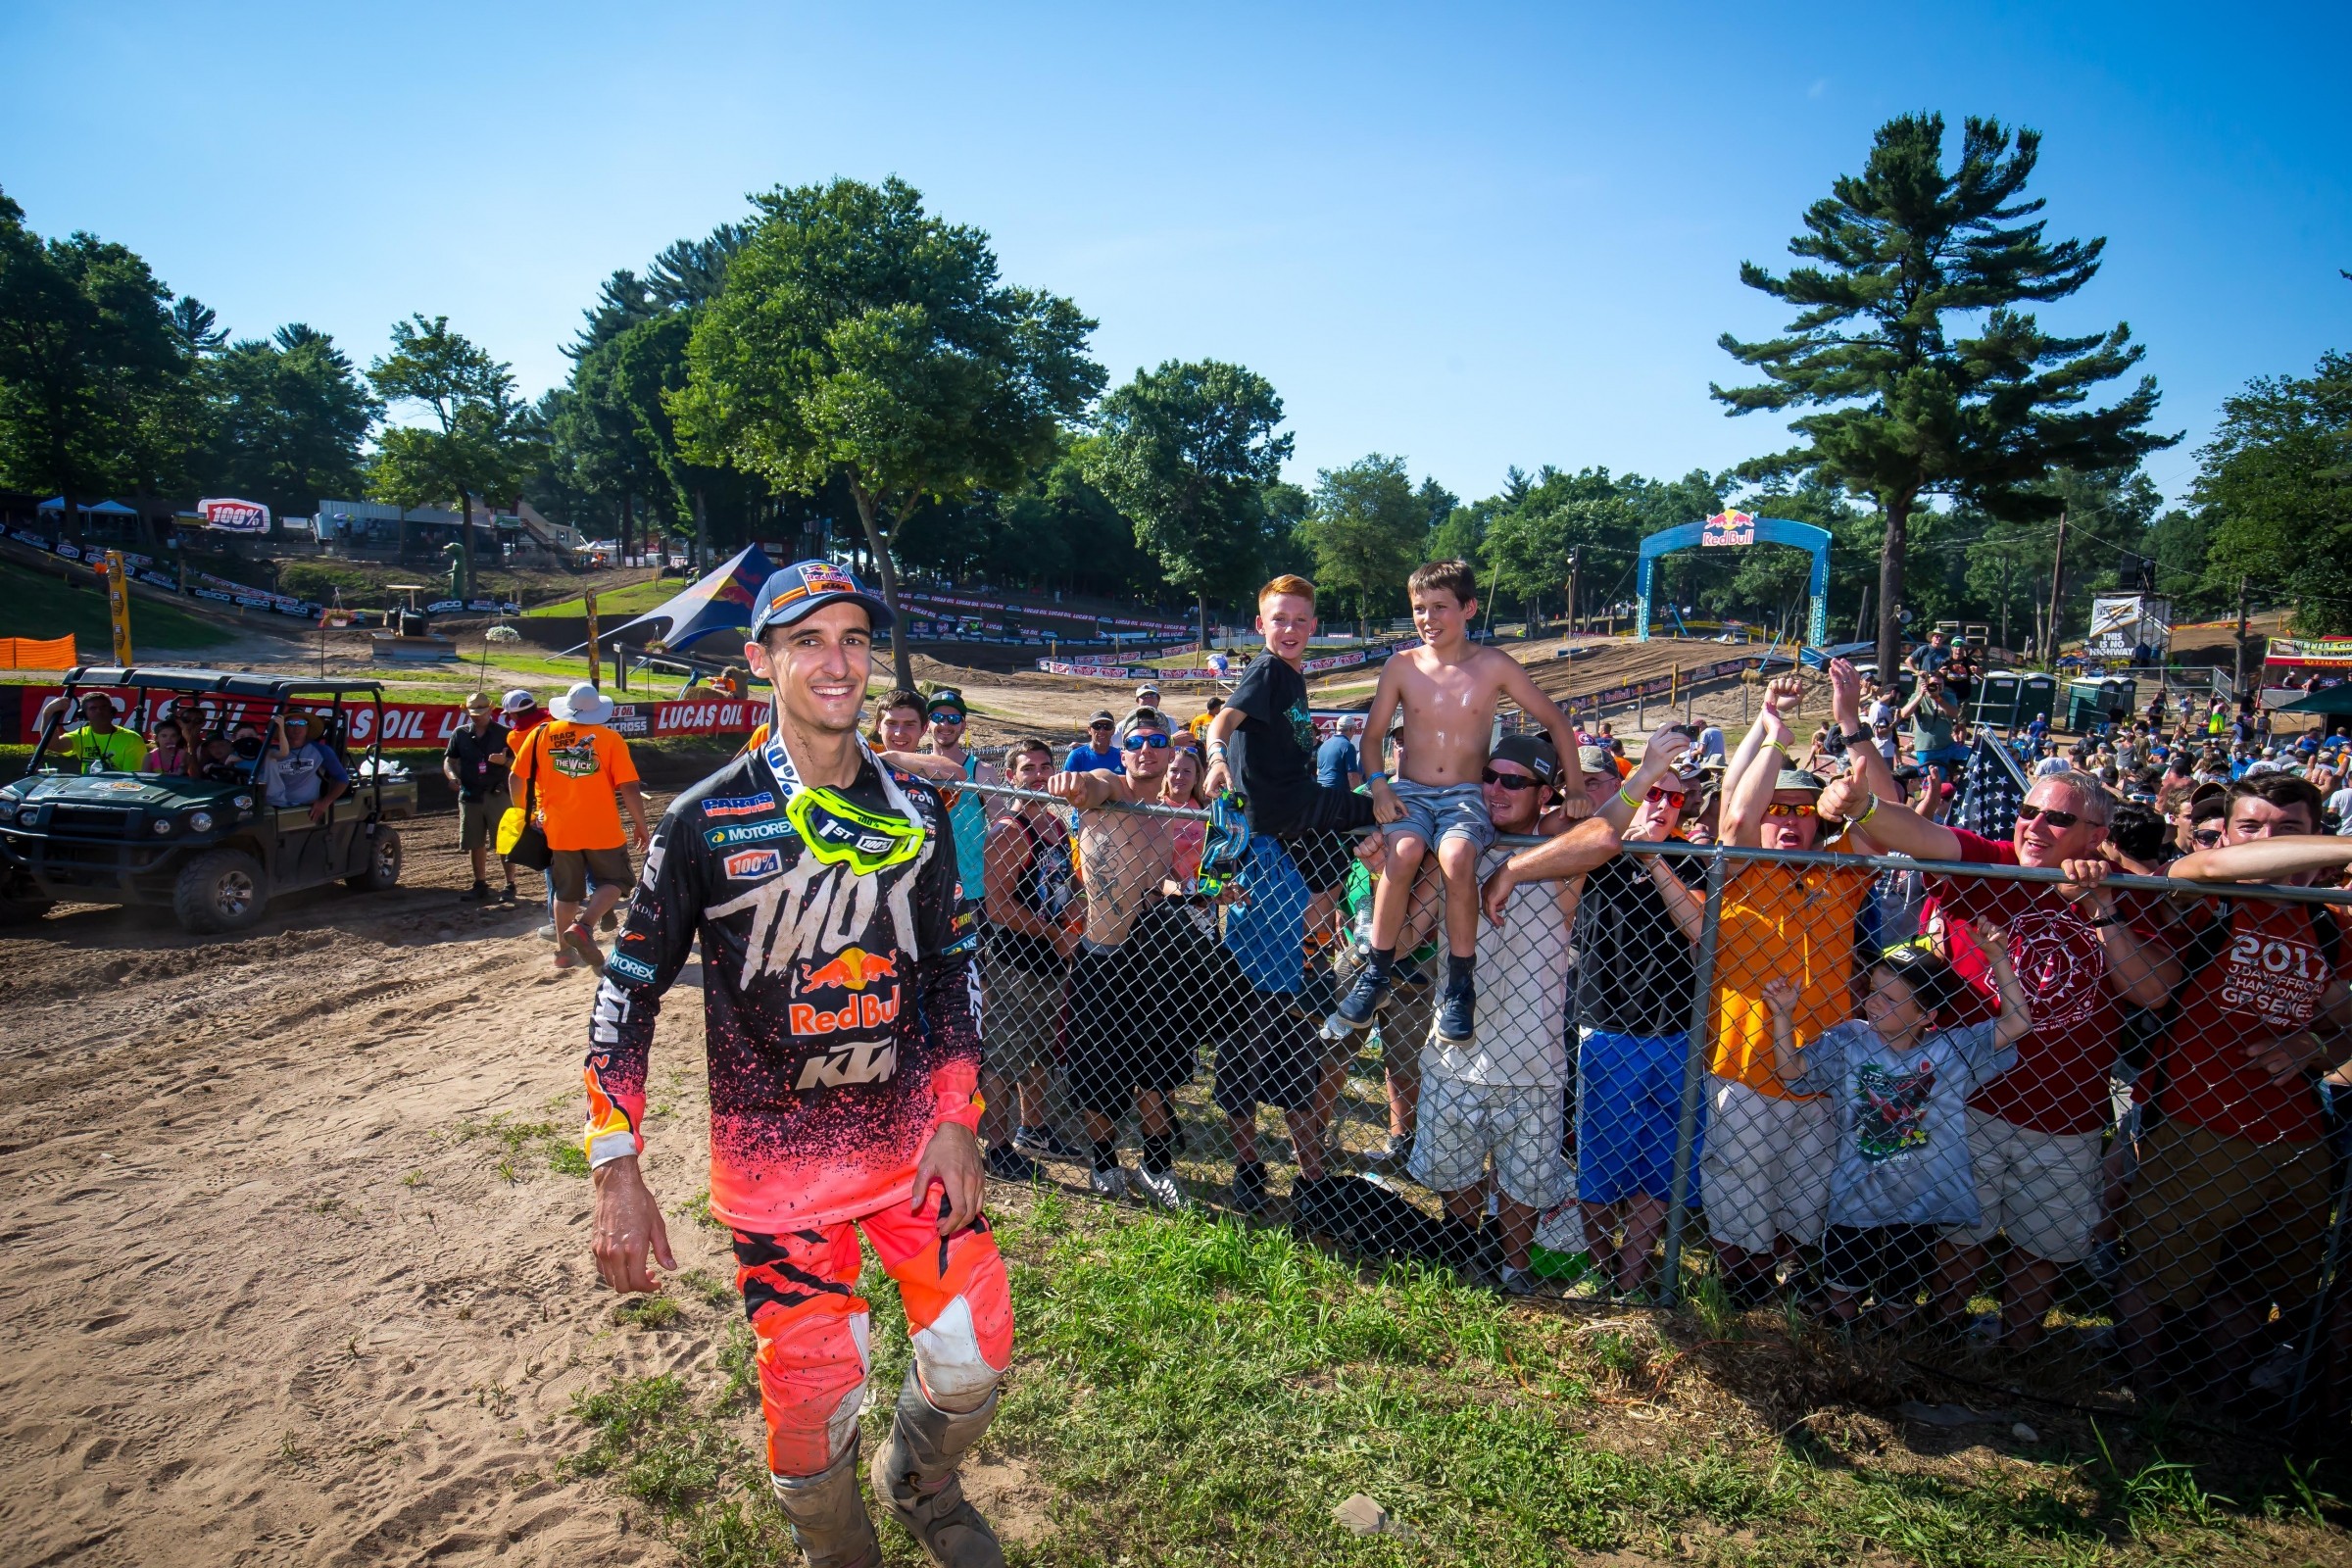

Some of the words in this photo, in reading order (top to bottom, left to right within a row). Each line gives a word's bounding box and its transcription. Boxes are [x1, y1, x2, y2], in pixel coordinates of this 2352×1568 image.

[212, 506, 260, 526] 100%
[1703, 530, 1728, 546] Red
[1728, 529, 1754, 546] Bull
[806, 572, 830, 582] Red
[830, 572, 851, 583] Bull
[196, 590, 230, 602] GEICO
[236, 597, 270, 608] GEICO
[275, 603, 309, 614] GEICO
[427, 601, 462, 612] GEICO
[909, 606, 927, 616] LUCAS
[986, 622, 1003, 631] LUCAS
[2102, 632, 2123, 641] THIS
[2089, 648, 2134, 657] HIGHWAY
[2293, 641, 2332, 652] KETTLE
[620, 706, 634, 716] OIL
[658, 705, 718, 730] LUCAS
[719, 704, 743, 726] OIL
[382, 710, 425, 739] OIL
[550, 731, 576, 742] TRACK
[554, 738, 576, 749] CREW
[555, 759, 569, 767] THE
[568, 758, 592, 770] WICK
[702, 791, 774, 811] PARTS
[706, 802, 776, 817] UNLIMITED
[818, 818, 856, 840] 1ST
[862, 839, 890, 851] 100%
[733, 854, 774, 875] 100%
[2230, 934, 2328, 981] 2017
[789, 993, 858, 1036] Red
[794, 1035, 898, 1092] KTM
